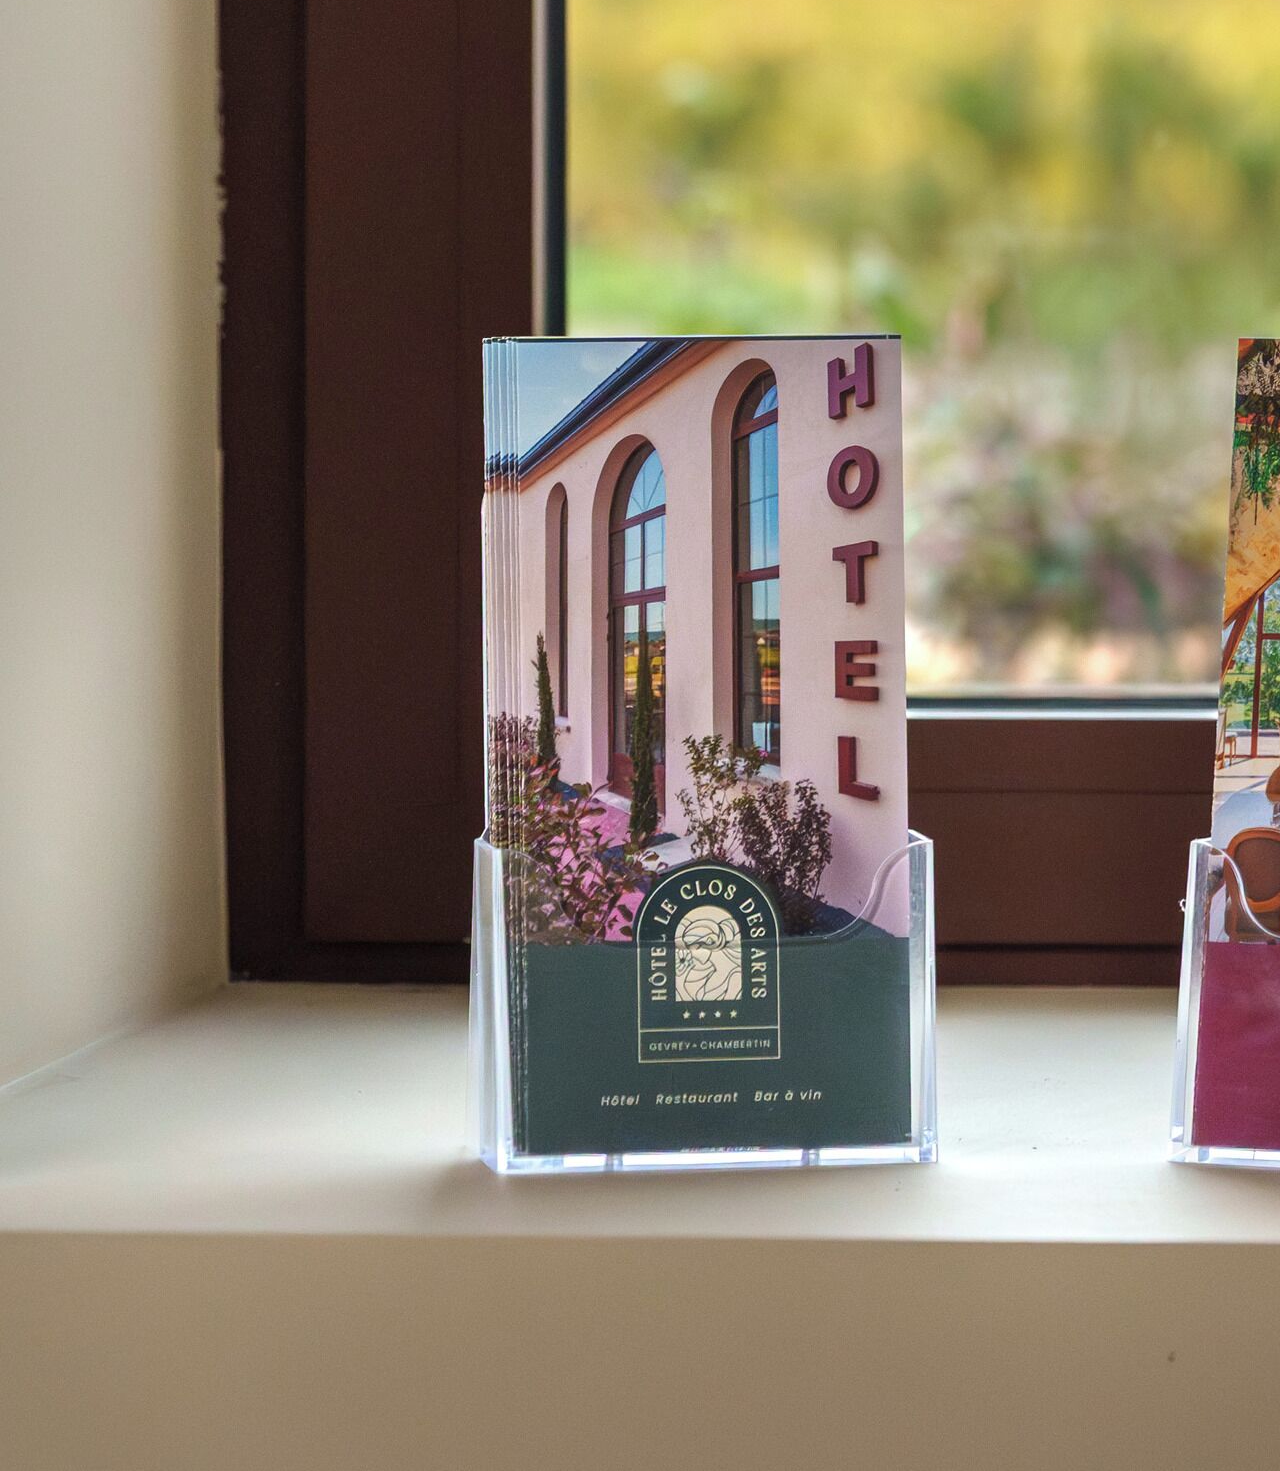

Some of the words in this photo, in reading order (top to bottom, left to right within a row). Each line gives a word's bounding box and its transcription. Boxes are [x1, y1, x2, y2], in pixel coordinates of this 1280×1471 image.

[826, 341, 880, 801] HOTEL
[680, 879, 737, 901] CLOS
[653, 899, 678, 925] LE
[739, 898, 766, 938] DES
[648, 933, 667, 1001] HÔTEL
[751, 947, 767, 999] ARTS
[601, 1094, 640, 1106] Hôtel
[655, 1091, 738, 1105] Restaurant
[754, 1090, 778, 1102] Bar
[784, 1089, 794, 1101] à
[800, 1089, 822, 1100] vin
